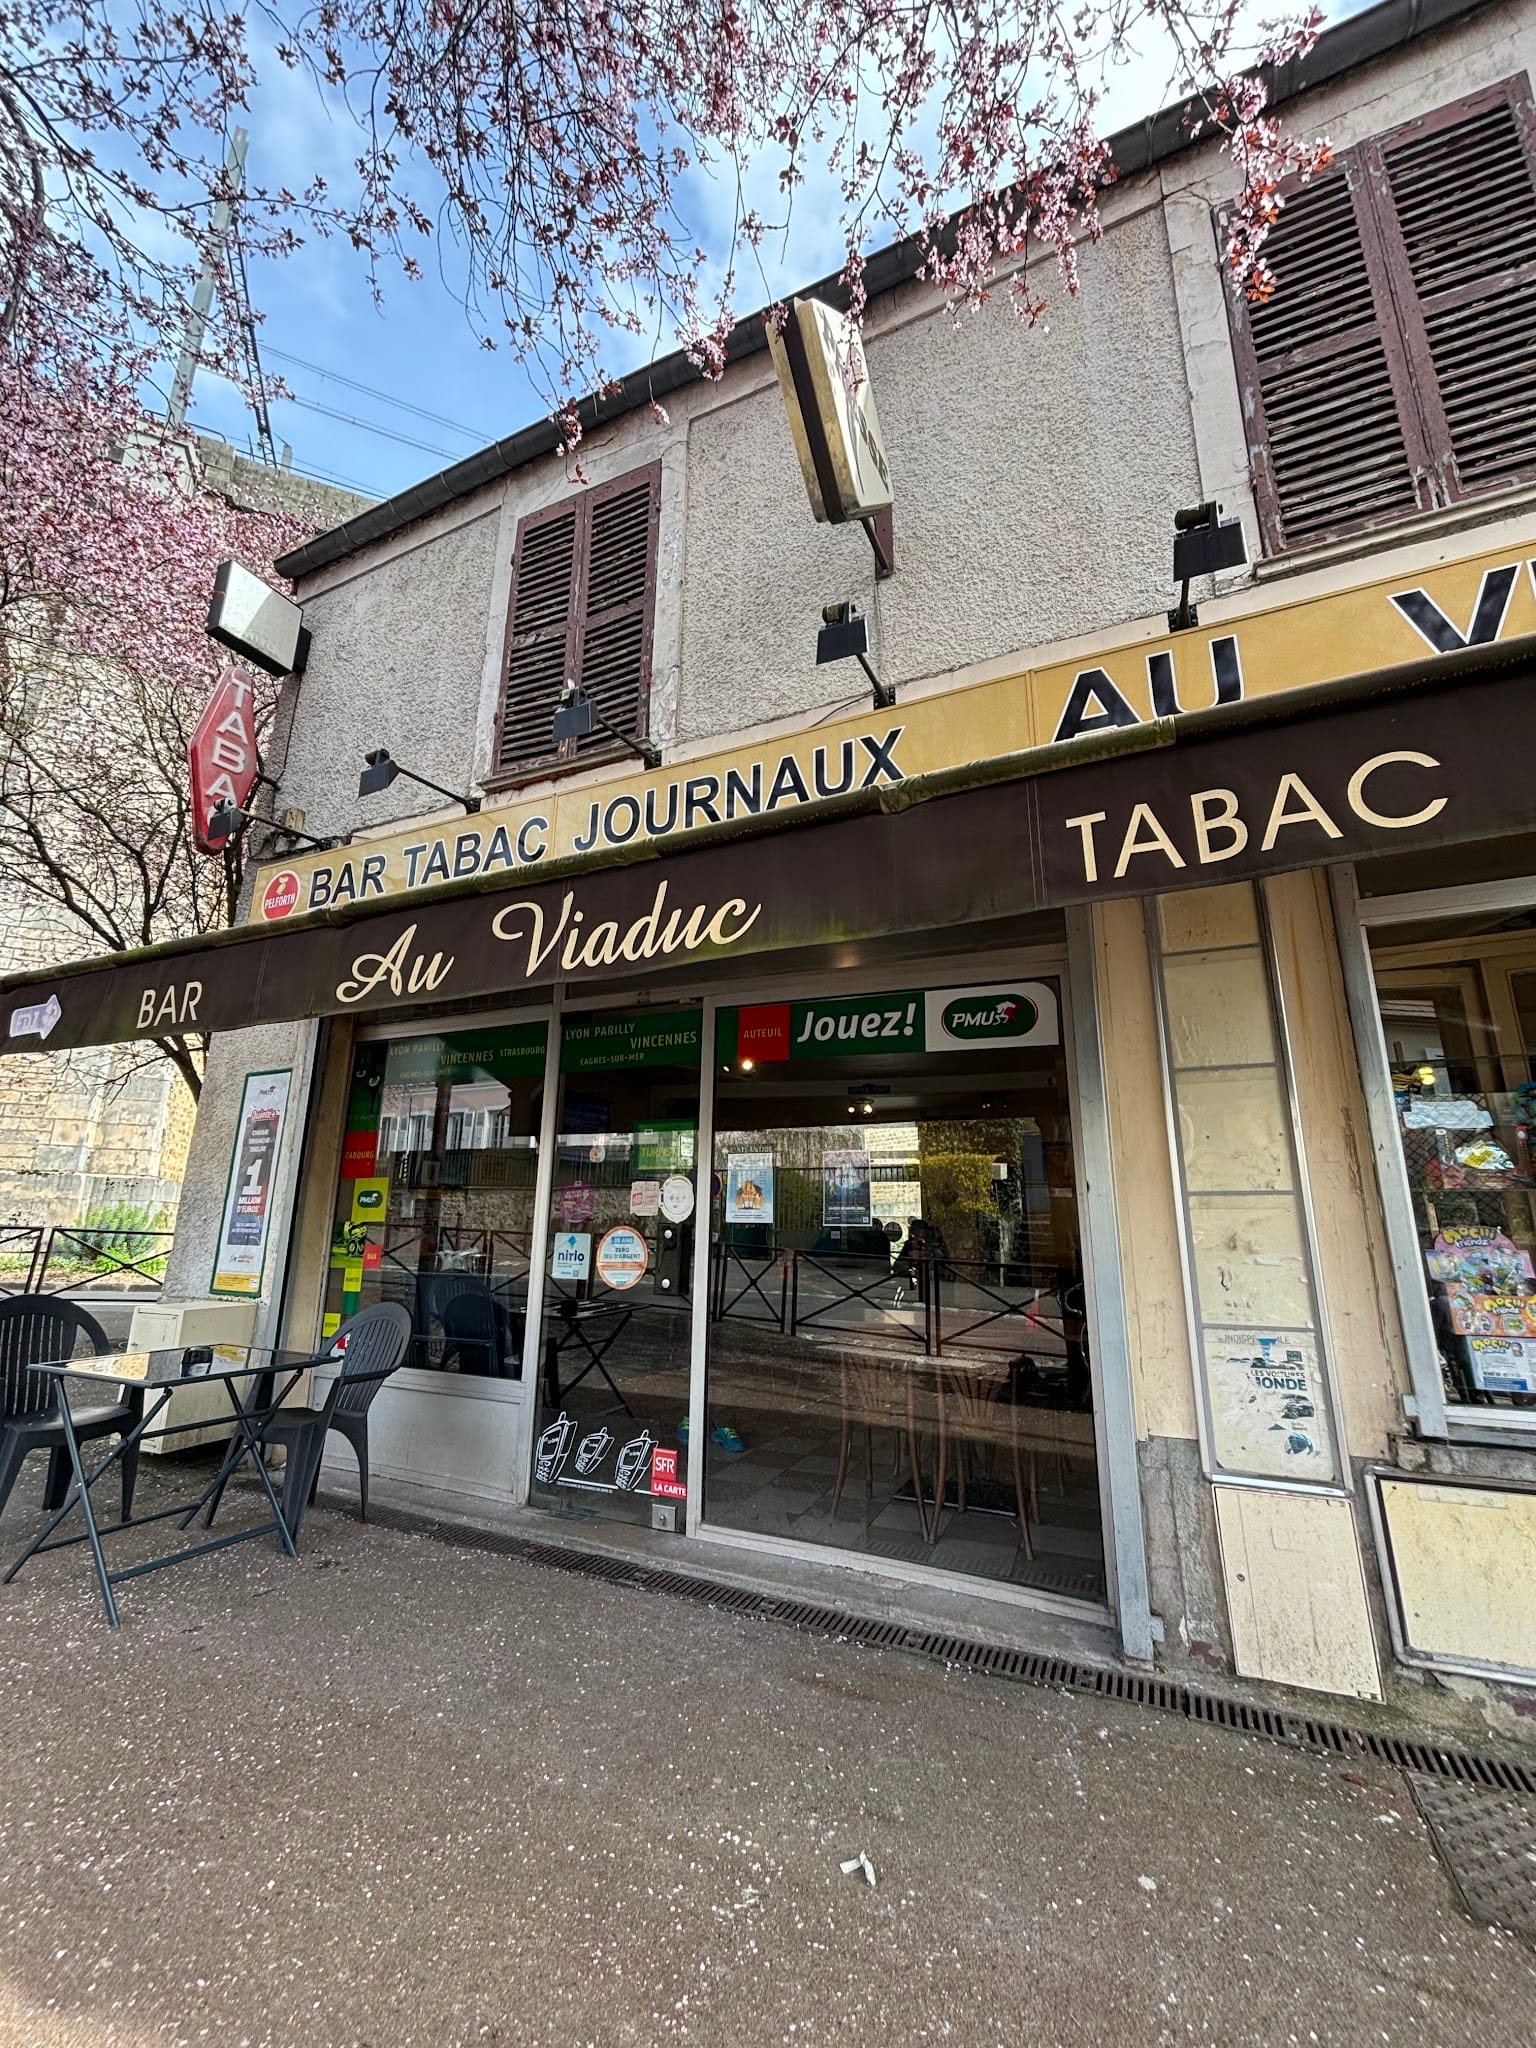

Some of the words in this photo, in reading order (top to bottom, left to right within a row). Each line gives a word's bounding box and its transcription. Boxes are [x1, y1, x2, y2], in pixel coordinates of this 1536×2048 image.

[1053, 634, 1244, 744] AU
[1388, 562, 1536, 656] V
[205, 678, 251, 830] TABA
[307, 854, 387, 909] BAR
[402, 815, 550, 888] TABAC
[572, 726, 906, 853] JOURNAUX
[1065, 750, 1450, 884] TABAC
[264, 893, 297, 910] PELFORTH
[136, 981, 203, 1029] BAR
[336, 923, 455, 1003] Au
[491, 880, 762, 978] Viaduc
[797, 1003, 917, 1043] Jouez!
[951, 1011, 996, 1028] PMU
[565, 1027, 590, 1040] LYON
[594, 1022, 636, 1037] PARILLY
[743, 1026, 783, 1039] AUTEUIL
[390, 1045, 410, 1056] LYON
[413, 1041, 447, 1054] PARILLY
[630, 1031, 697, 1049] VINCENNES
[441, 1050, 494, 1065] VINCENNES
[500, 1045, 545, 1057] STRASBOURG
[580, 1052, 645, 1066] CAGNES-SUR-MER
[345, 1151, 375, 1160] CABOURG
[241, 1159, 263, 1195] 1
[558, 1249, 585, 1262] nirio
[1224, 1334, 1291, 1345] INDISPELE
[655, 1456, 674, 1474] SFR
[654, 1483, 662, 1491] LA
[664, 1485, 687, 1497] CARTE
